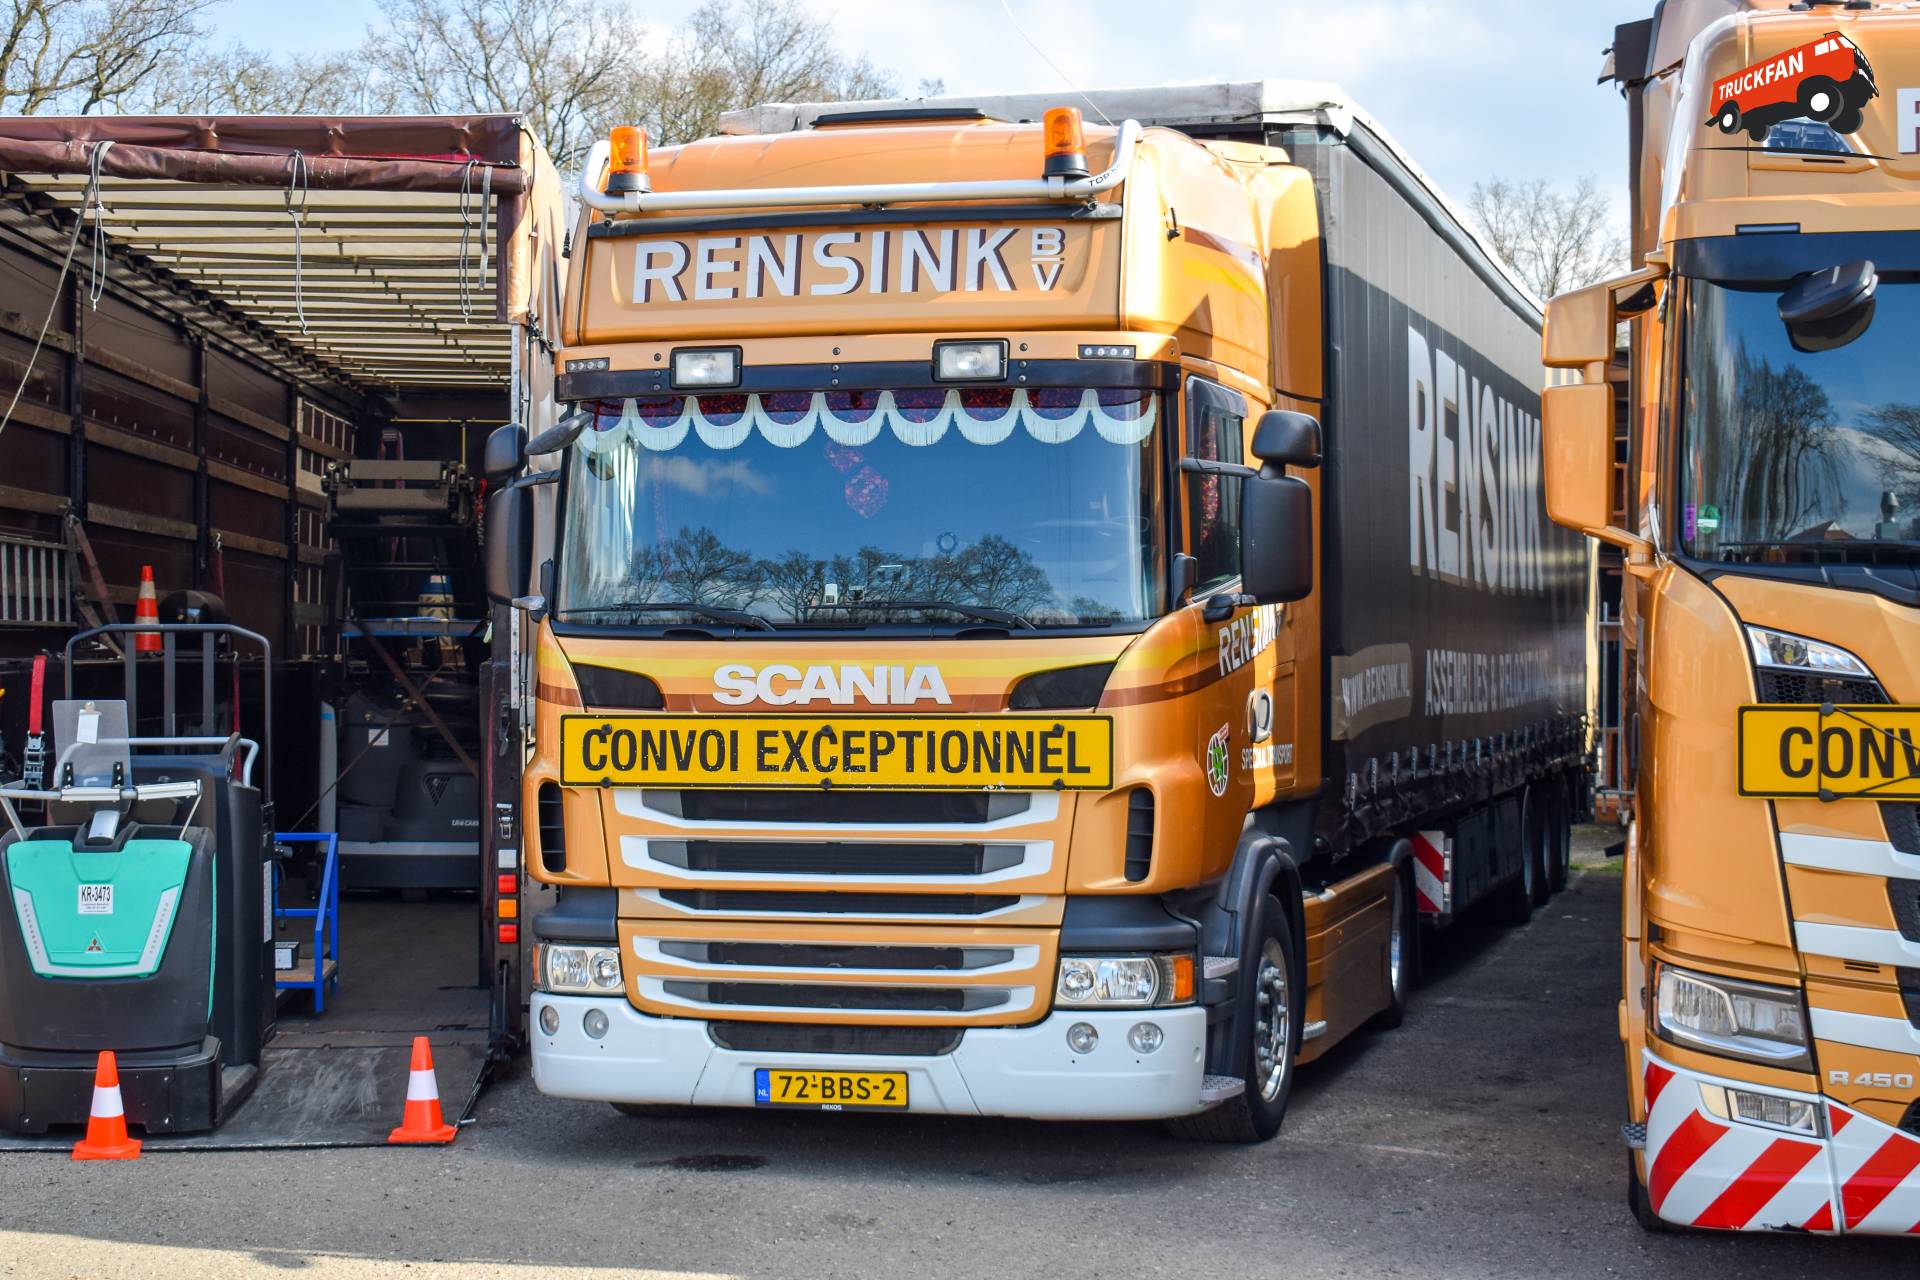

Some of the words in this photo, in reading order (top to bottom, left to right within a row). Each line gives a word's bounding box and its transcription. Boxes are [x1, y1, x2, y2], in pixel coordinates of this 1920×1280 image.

[632, 228, 1020, 304] RENSINK
[1408, 325, 1544, 593] RENSINK
[1218, 602, 1277, 677] RENSINK
[712, 664, 953, 706] SCANIA
[1425, 649, 1489, 717] ASSEMBLIES
[582, 728, 739, 772] CONVOI
[757, 729, 1091, 774] EXCEPTIONNEL
[81, 886, 111, 902] KR-3473
[758, 1088, 769, 1097] NL
[778, 1075, 897, 1101] 72-BBS-2
[1828, 1070, 1849, 1086] R
[1854, 1072, 1913, 1088] 450
